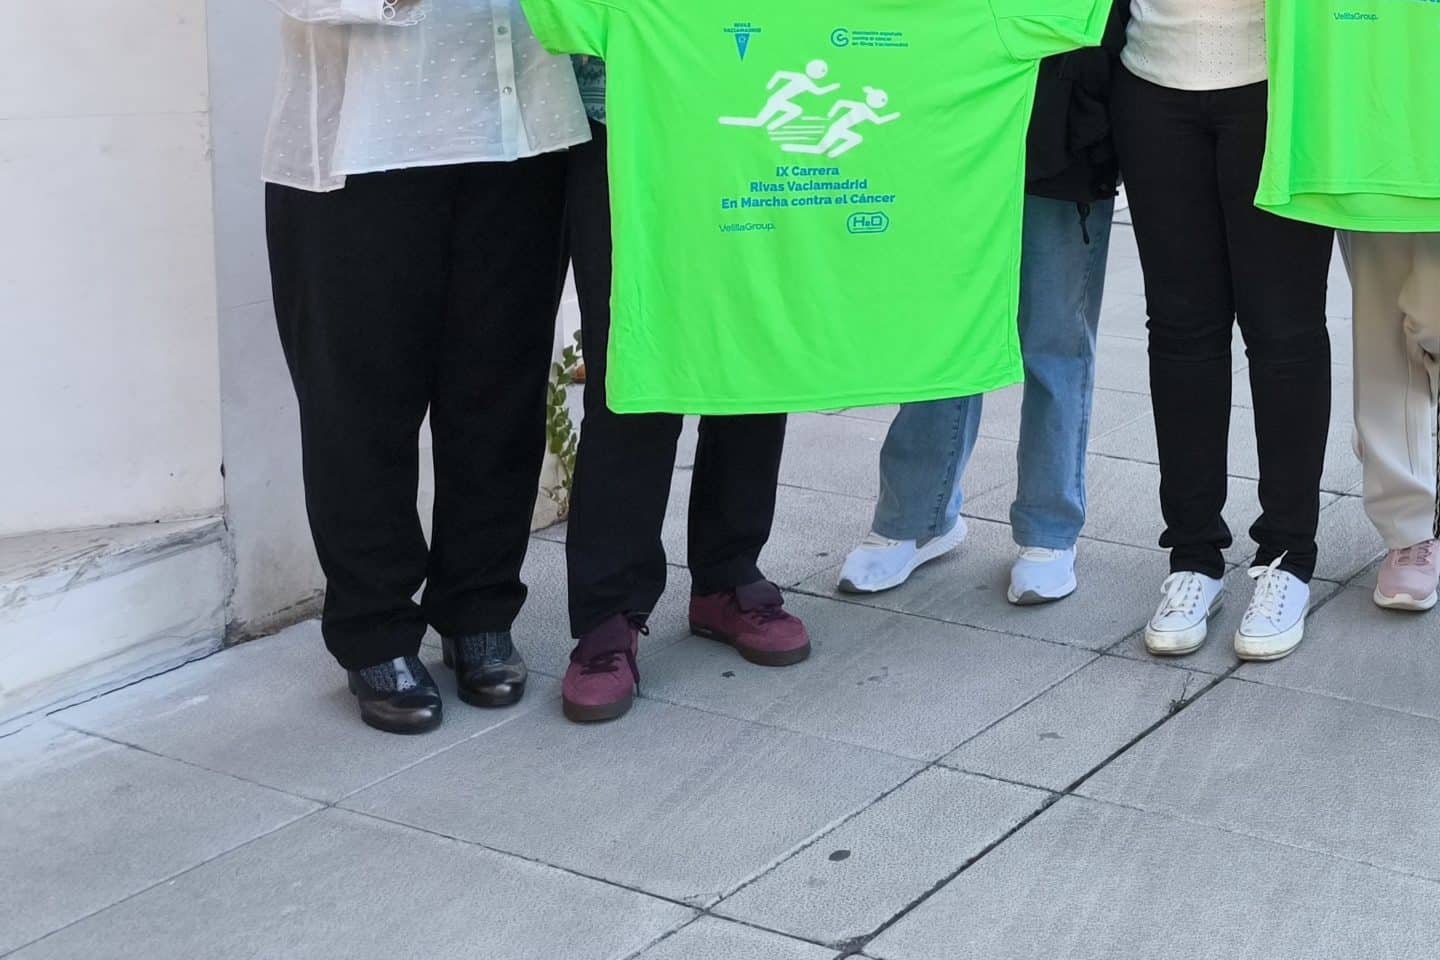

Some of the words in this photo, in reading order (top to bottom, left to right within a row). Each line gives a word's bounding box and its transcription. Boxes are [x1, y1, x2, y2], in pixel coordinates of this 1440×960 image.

[776, 166, 789, 177] IX
[791, 166, 840, 177] Carrera
[750, 181, 785, 193] Rivas
[787, 178, 868, 192] Vaciamadrid
[721, 198, 738, 209] En
[741, 196, 788, 208] Marcha
[791, 196, 832, 207] contra
[835, 194, 848, 205] el
[850, 192, 896, 204] Cáncer
